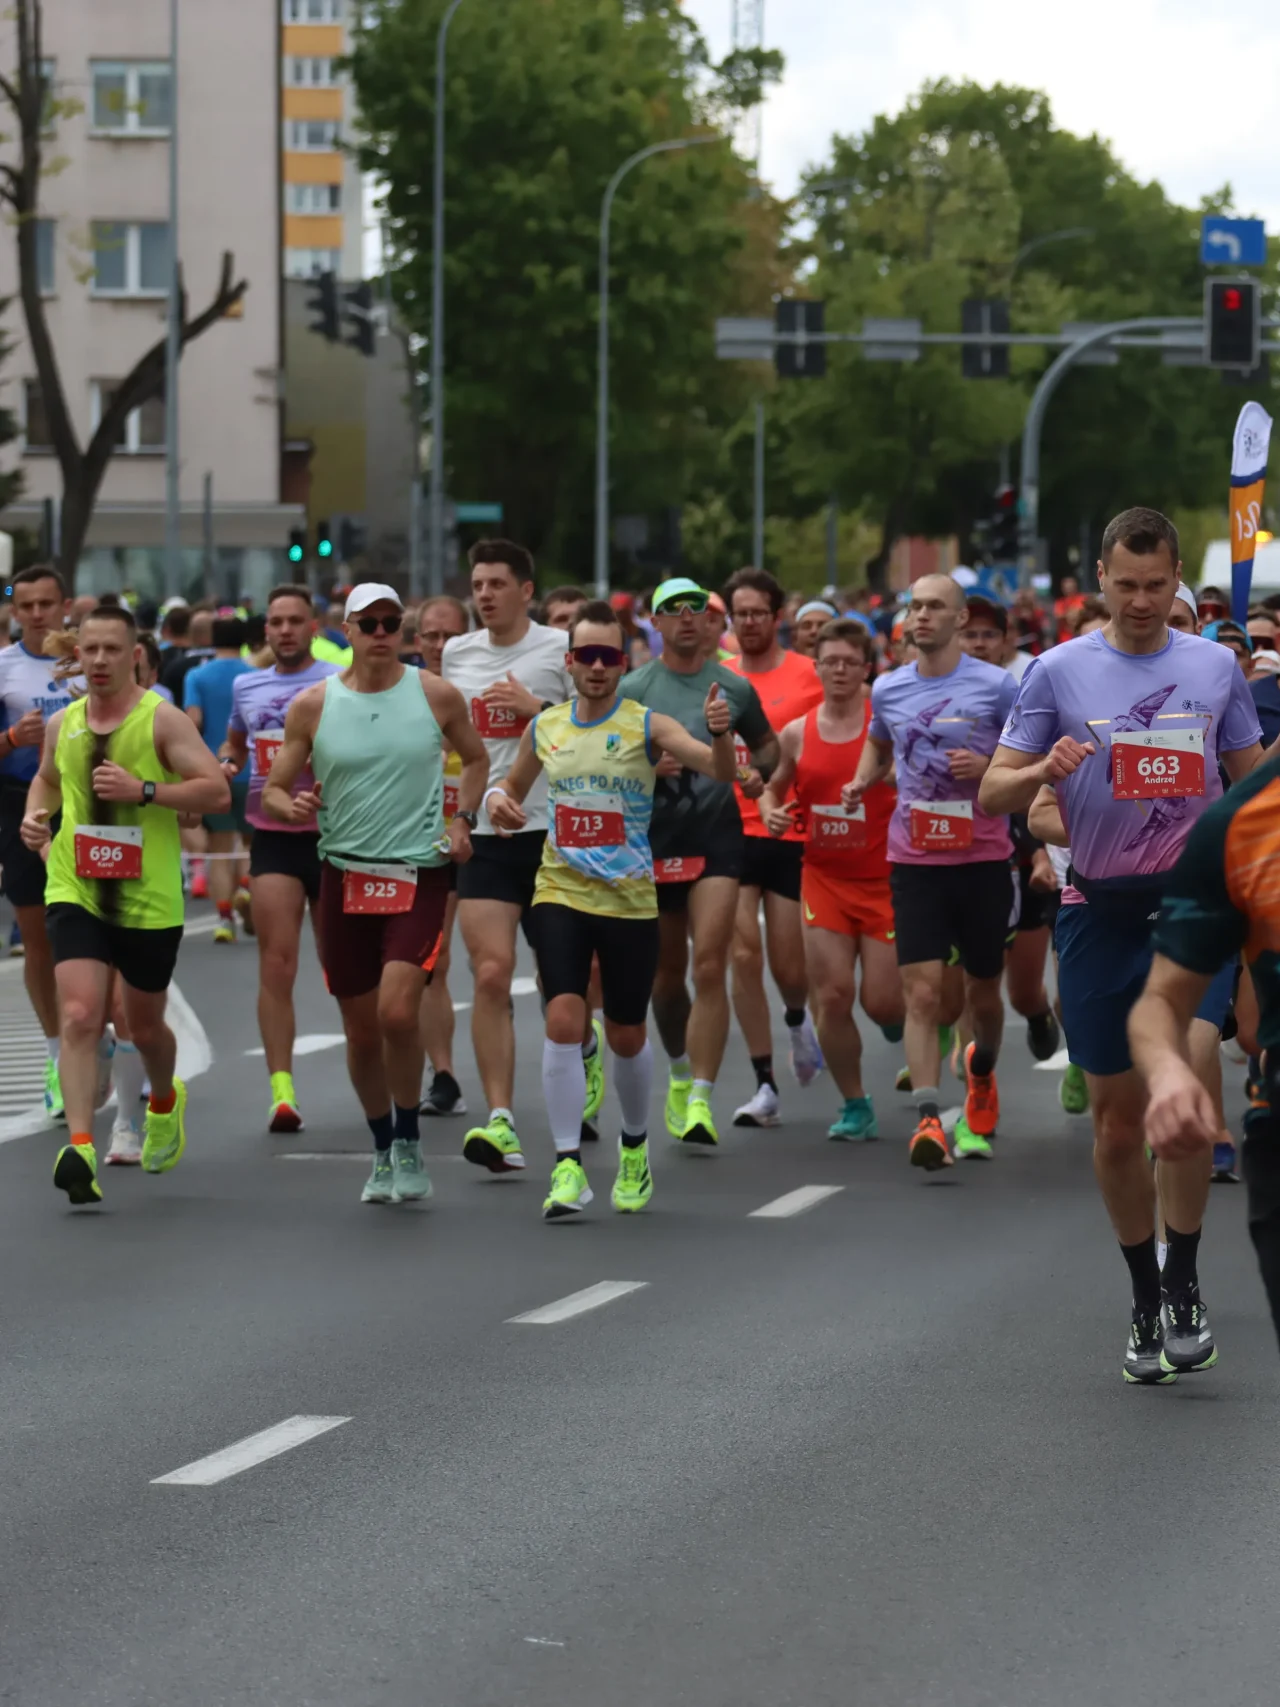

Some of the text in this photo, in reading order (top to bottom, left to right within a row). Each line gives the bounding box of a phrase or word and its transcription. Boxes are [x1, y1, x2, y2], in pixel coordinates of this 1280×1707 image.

[1137, 755, 1181, 776] 663
[589, 775, 608, 789] PO
[1144, 775, 1176, 785] Andrzej
[570, 815, 604, 832] 713
[821, 821, 850, 836] 920
[928, 819, 951, 834] 78
[89, 845, 124, 861] 696
[363, 882, 398, 898] 925
